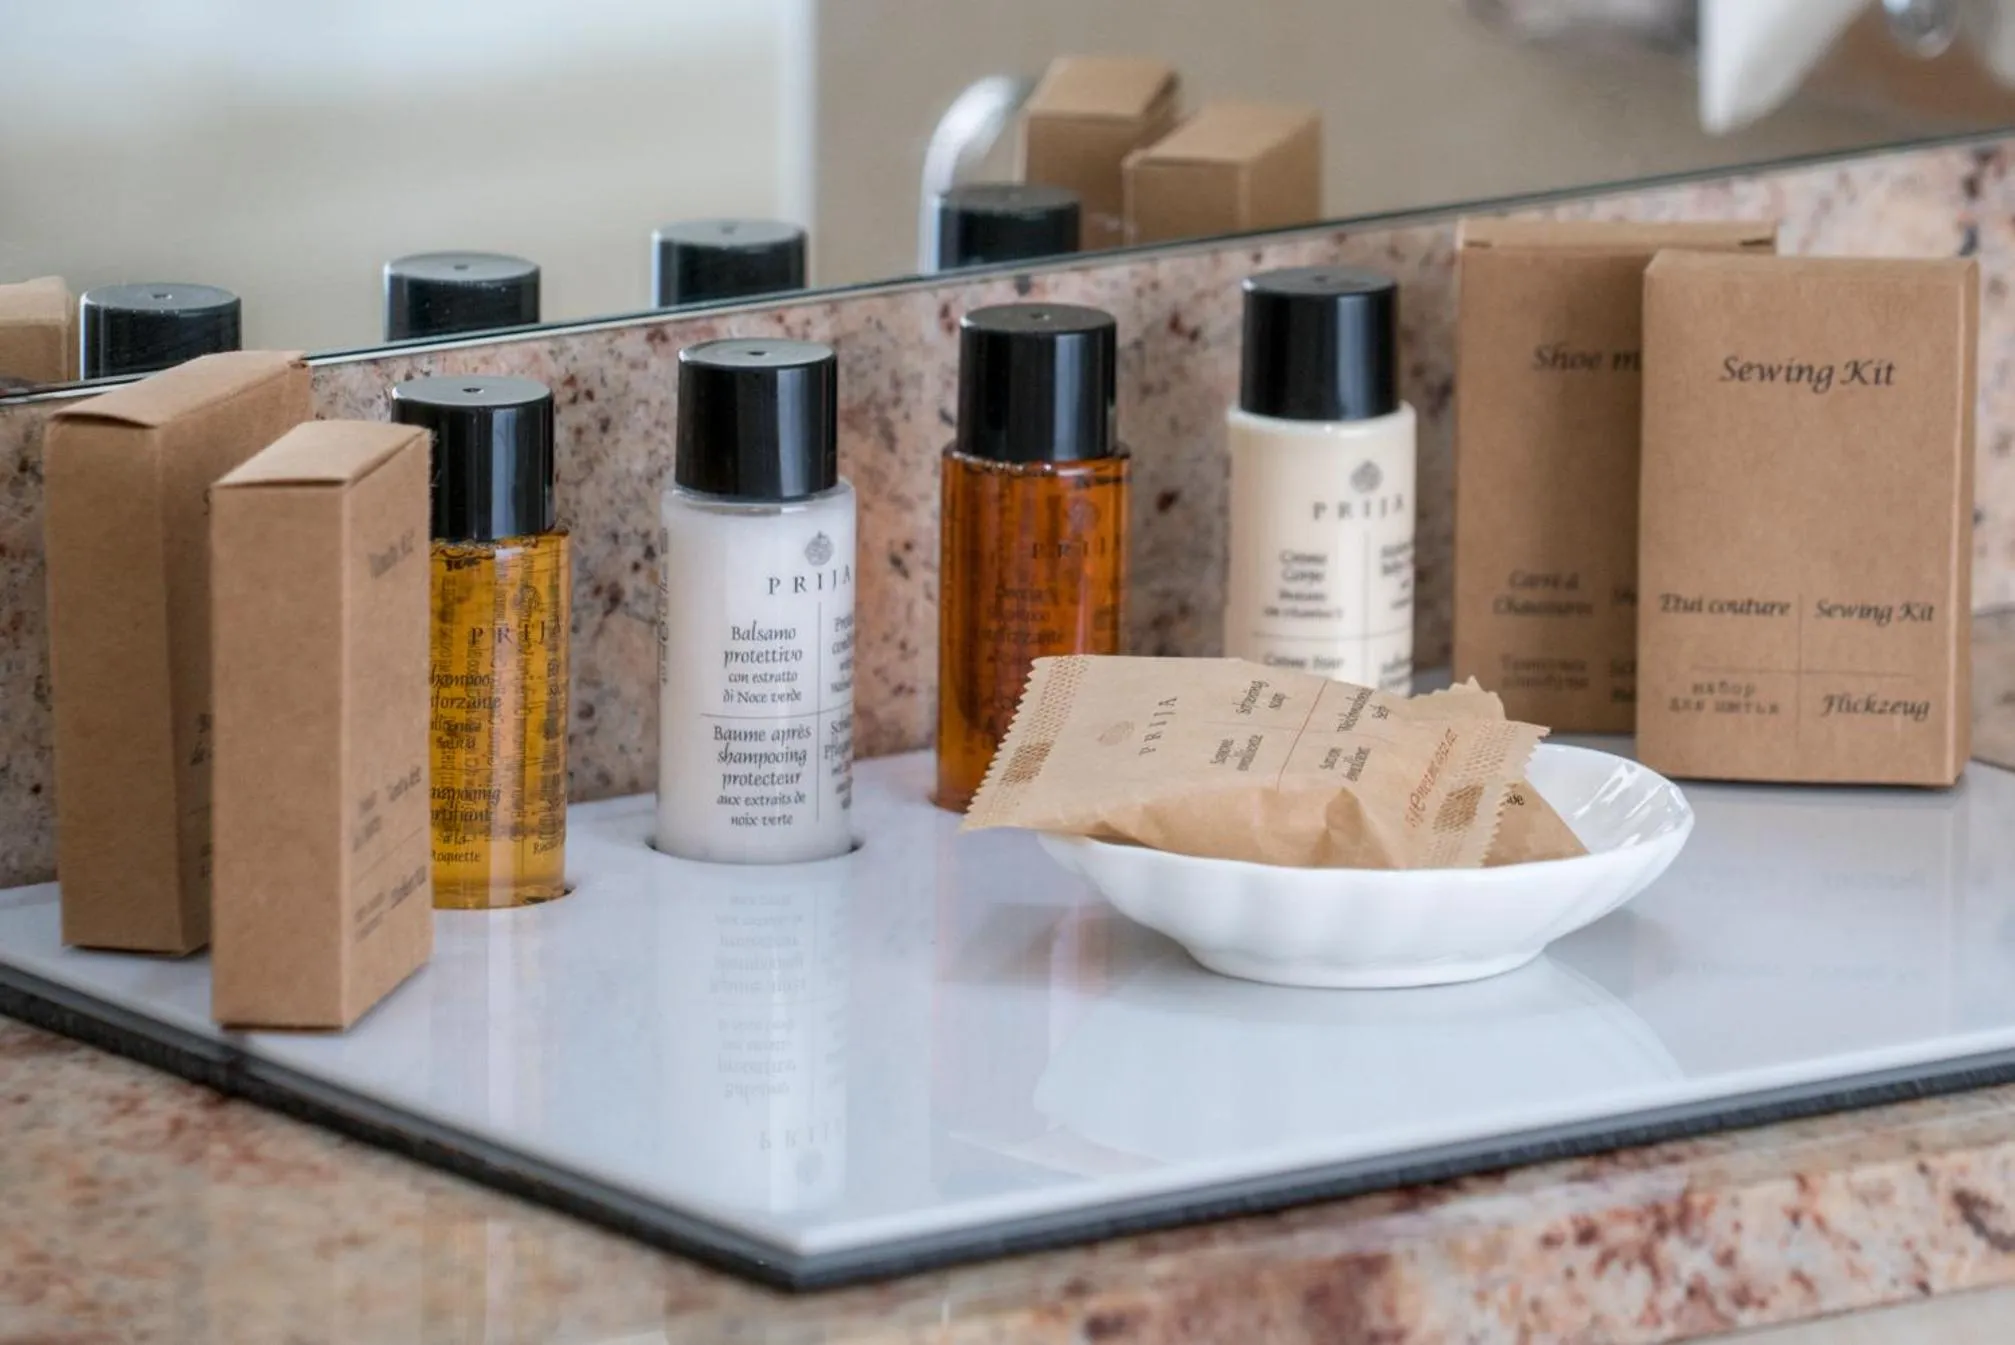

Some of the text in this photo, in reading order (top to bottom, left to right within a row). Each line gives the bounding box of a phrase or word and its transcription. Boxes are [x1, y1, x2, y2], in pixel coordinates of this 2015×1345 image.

[1531, 341, 1641, 372] Shoe m
[1719, 355, 1896, 394] Sewing Kit
[768, 565, 852, 595] PRIJA
[1707, 596, 1792, 617] couture
[1814, 598, 1935, 628] Sewing Kit
[731, 619, 796, 641] Balsamo
[723, 645, 803, 669] protettivo
[429, 663, 491, 694] hampoo
[728, 670, 798, 684] con estratto
[723, 687, 802, 704] di Noce verde
[1820, 692, 1931, 722] Flickzeug
[713, 724, 766, 742] Baume
[771, 723, 812, 747] après
[1138, 697, 1178, 756] PRIJA
[717, 741, 807, 769] shampooing
[722, 771, 801, 791] protecteur
[716, 789, 806, 807] aux extraits de
[730, 811, 793, 827] noix verte
